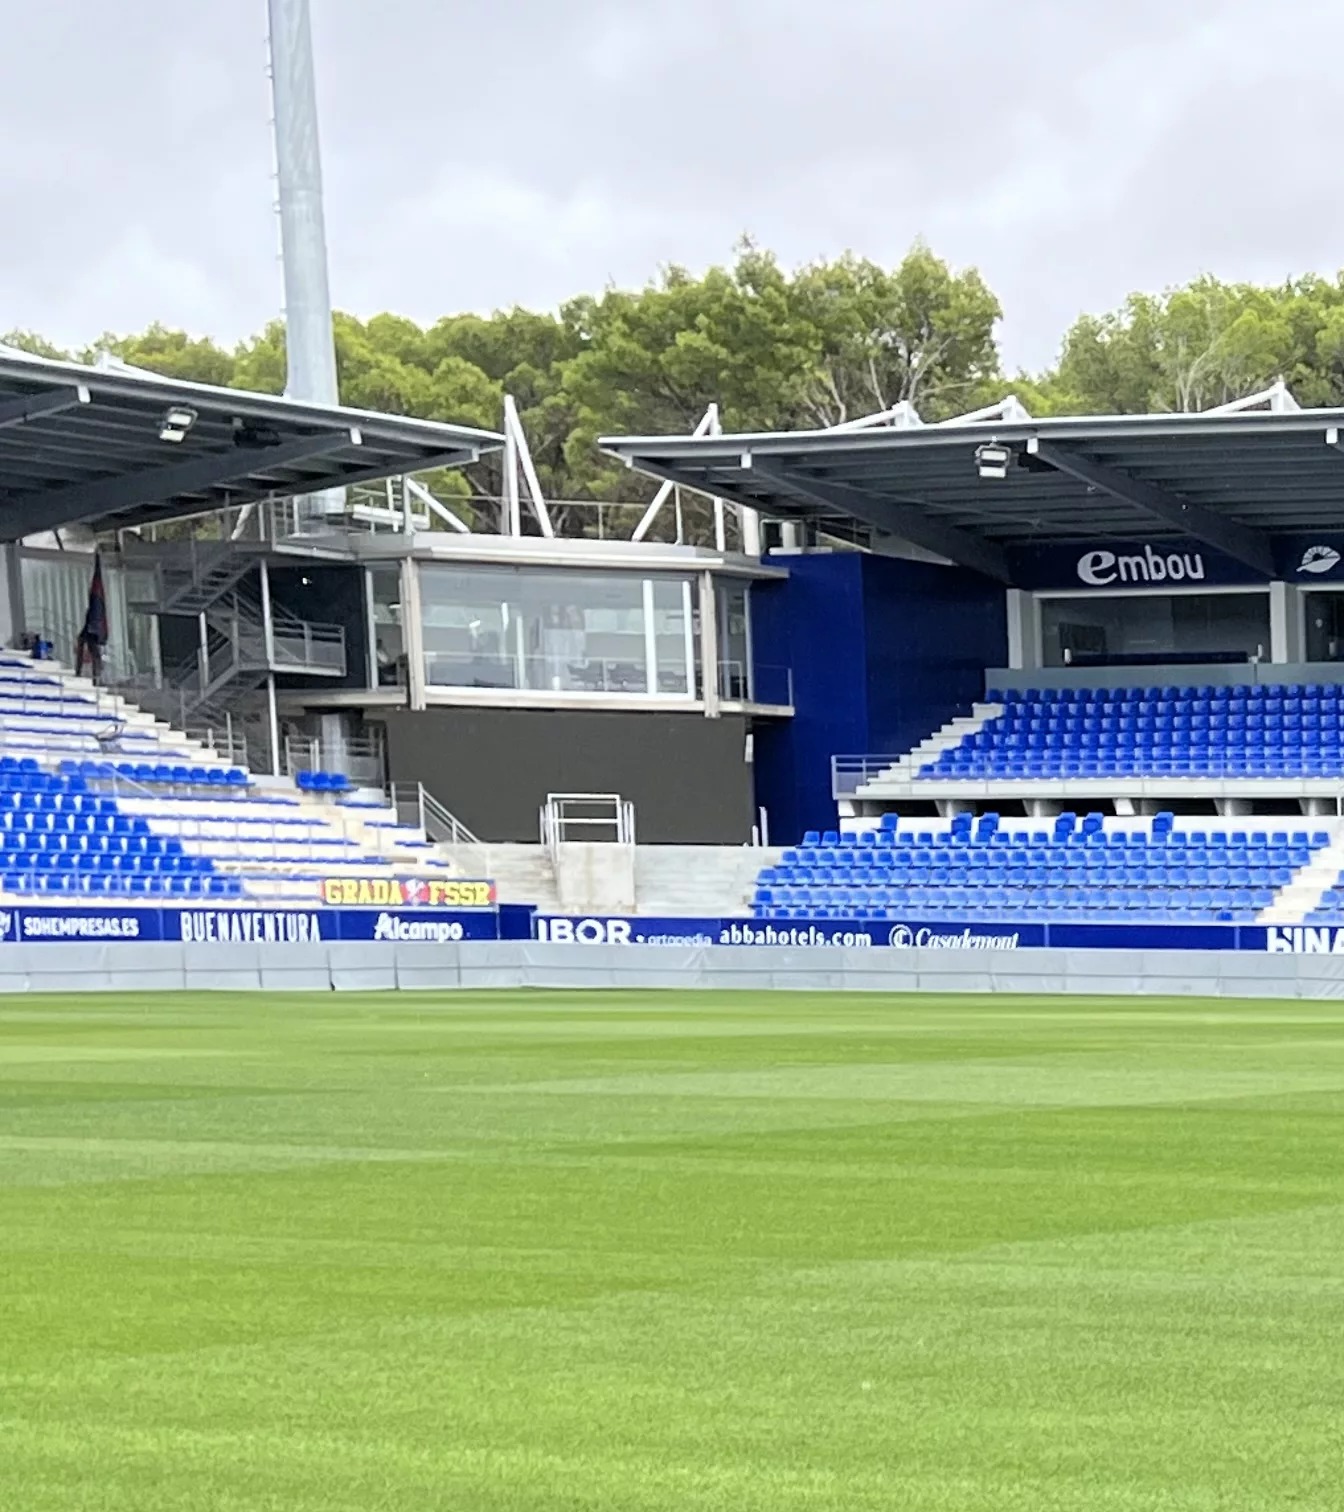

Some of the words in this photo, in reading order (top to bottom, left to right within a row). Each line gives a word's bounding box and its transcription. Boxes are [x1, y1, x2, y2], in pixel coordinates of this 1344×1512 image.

[1077, 544, 1205, 585] embou
[325, 879, 404, 905] GRADA
[181, 912, 321, 943] BUENAVENTURA
[374, 912, 464, 943] Alcampo
[537, 918, 632, 944] IBOR
[719, 926, 872, 948] abbahotels.com
[914, 927, 1020, 950] Casademont
